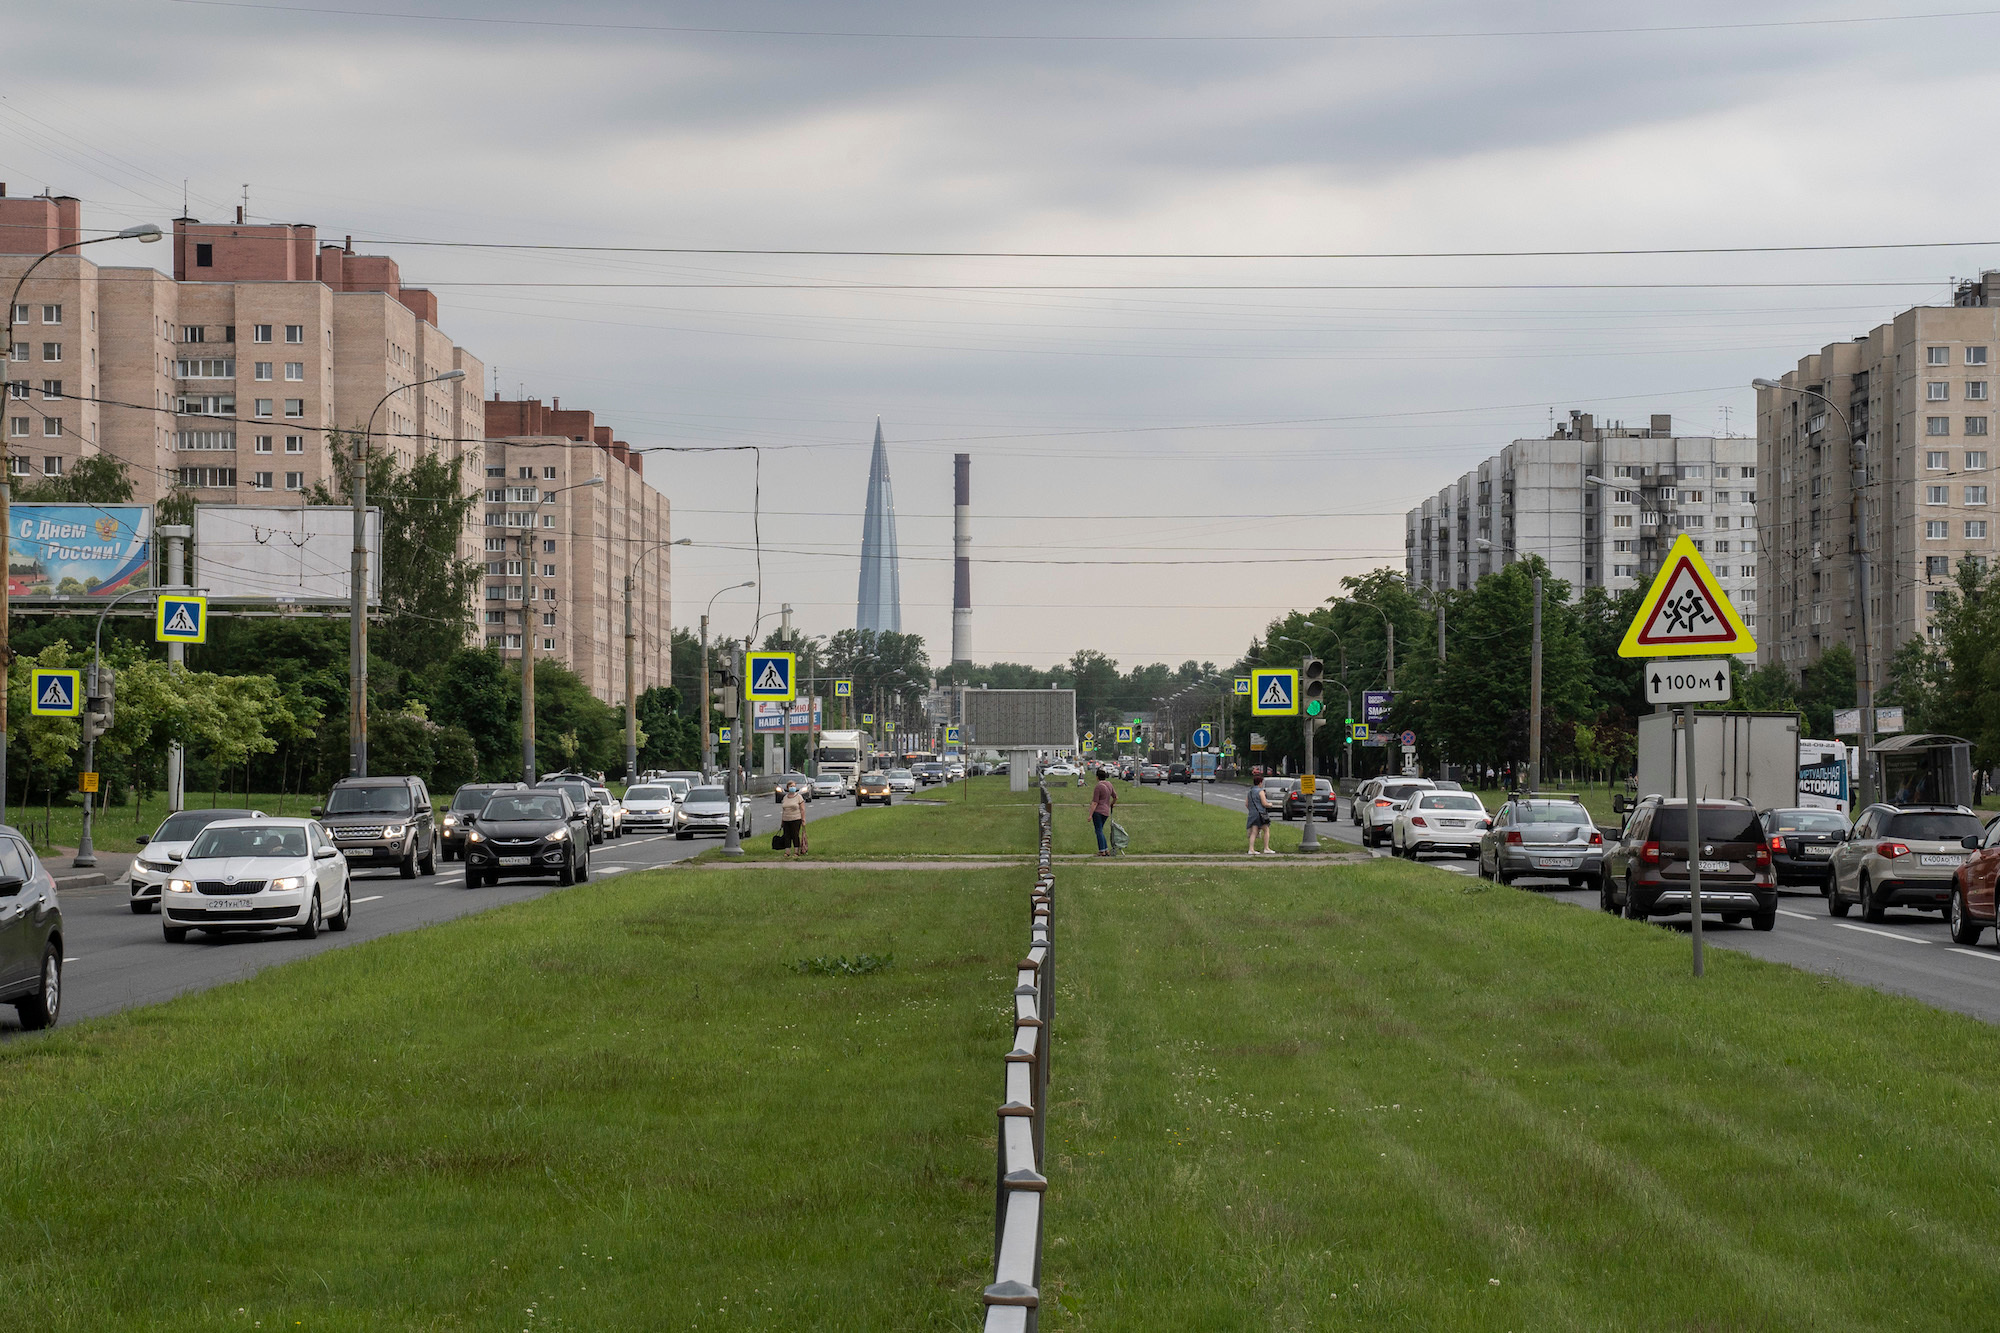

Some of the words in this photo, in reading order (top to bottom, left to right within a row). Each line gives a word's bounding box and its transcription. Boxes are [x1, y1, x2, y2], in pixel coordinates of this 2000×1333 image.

[20, 519, 33, 538] С
[36, 520, 87, 540] Днем
[47, 541, 121, 560] России!
[1666, 674, 1696, 690] 100
[758, 716, 781, 728] НАШЕ
[1799, 765, 1841, 781] ИРТУАЛЬНАЯ
